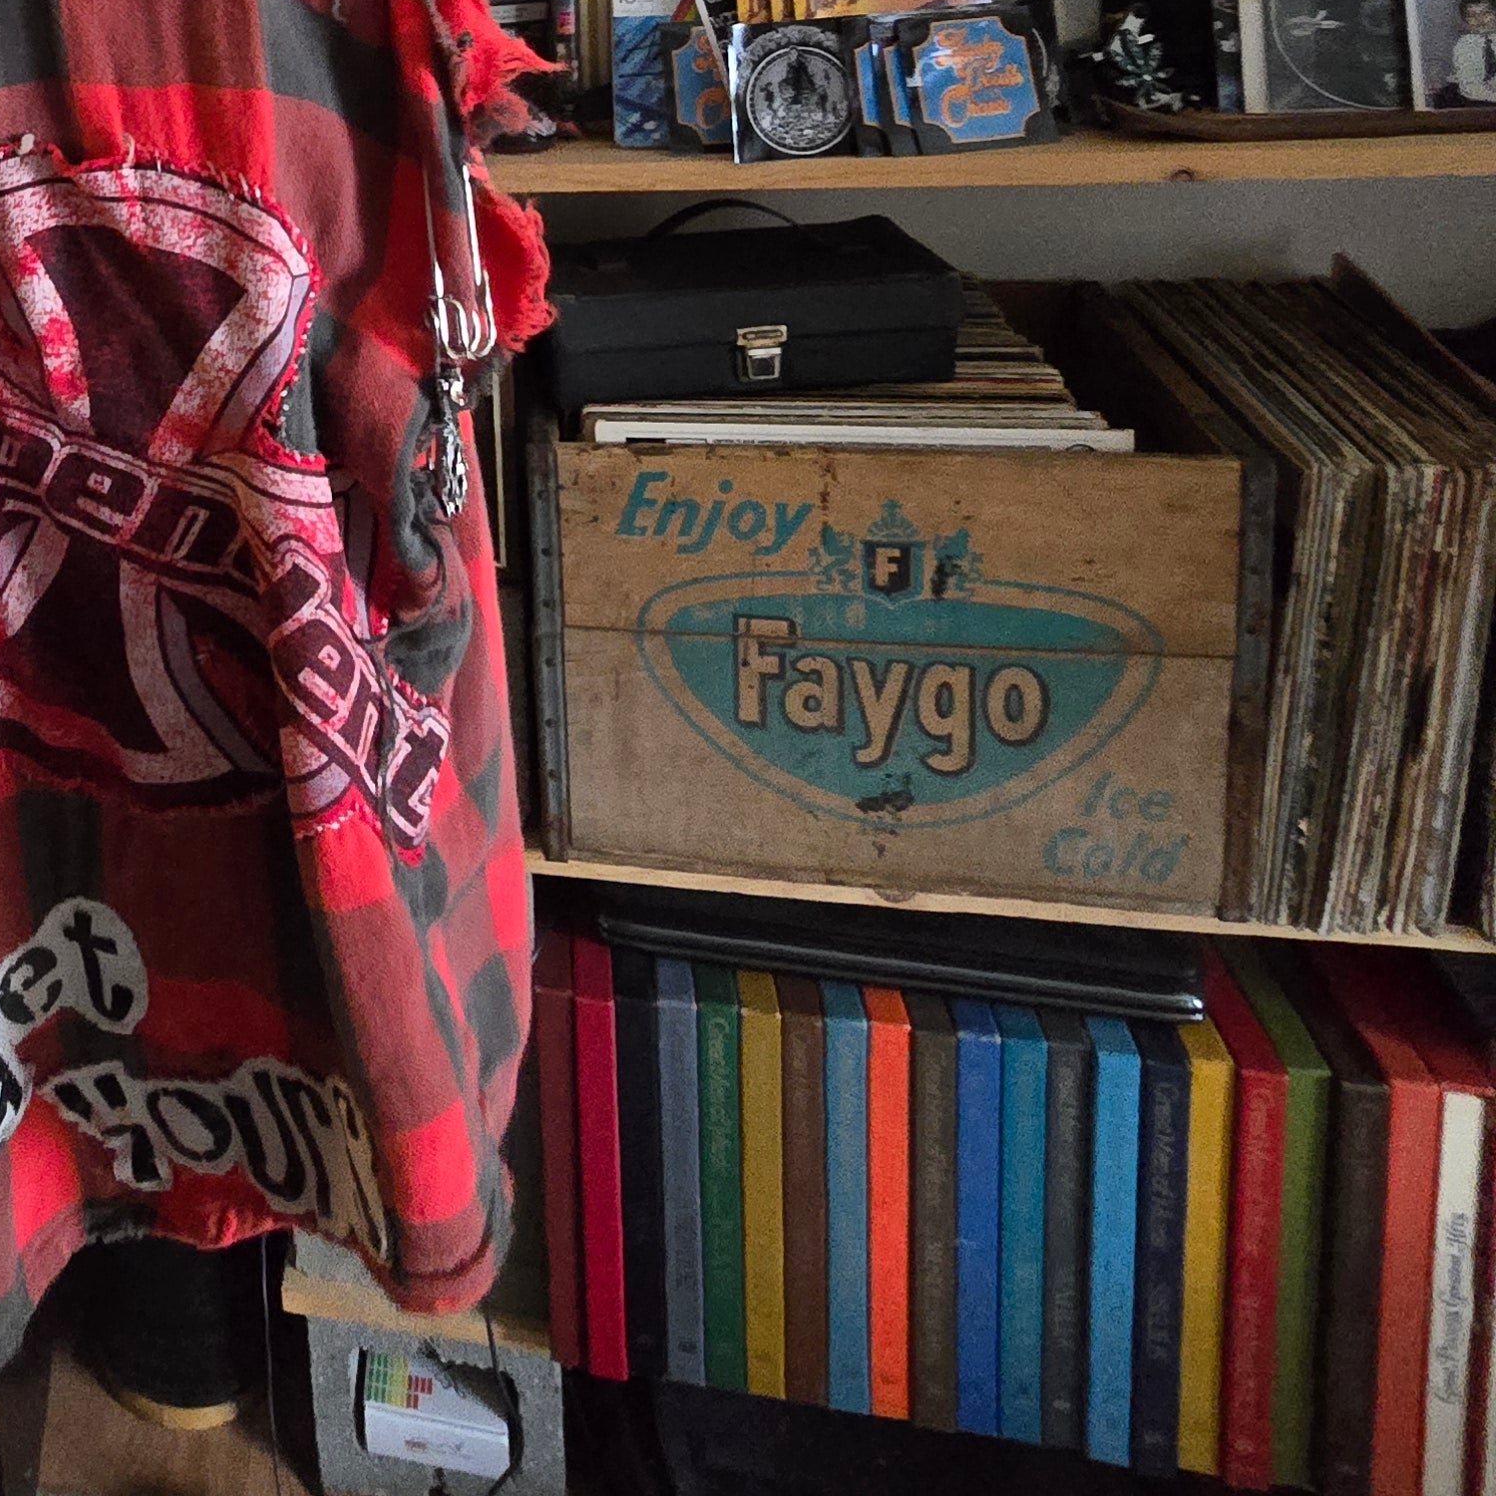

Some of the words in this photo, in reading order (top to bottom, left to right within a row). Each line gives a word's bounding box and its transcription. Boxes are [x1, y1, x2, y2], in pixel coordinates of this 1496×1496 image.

[615, 471, 813, 556] Enjoy
[872, 547, 903, 587] F
[731, 612, 1052, 777] Faygo
[1079, 772, 1175, 822] Ice
[1040, 827, 1189, 884] Cold
